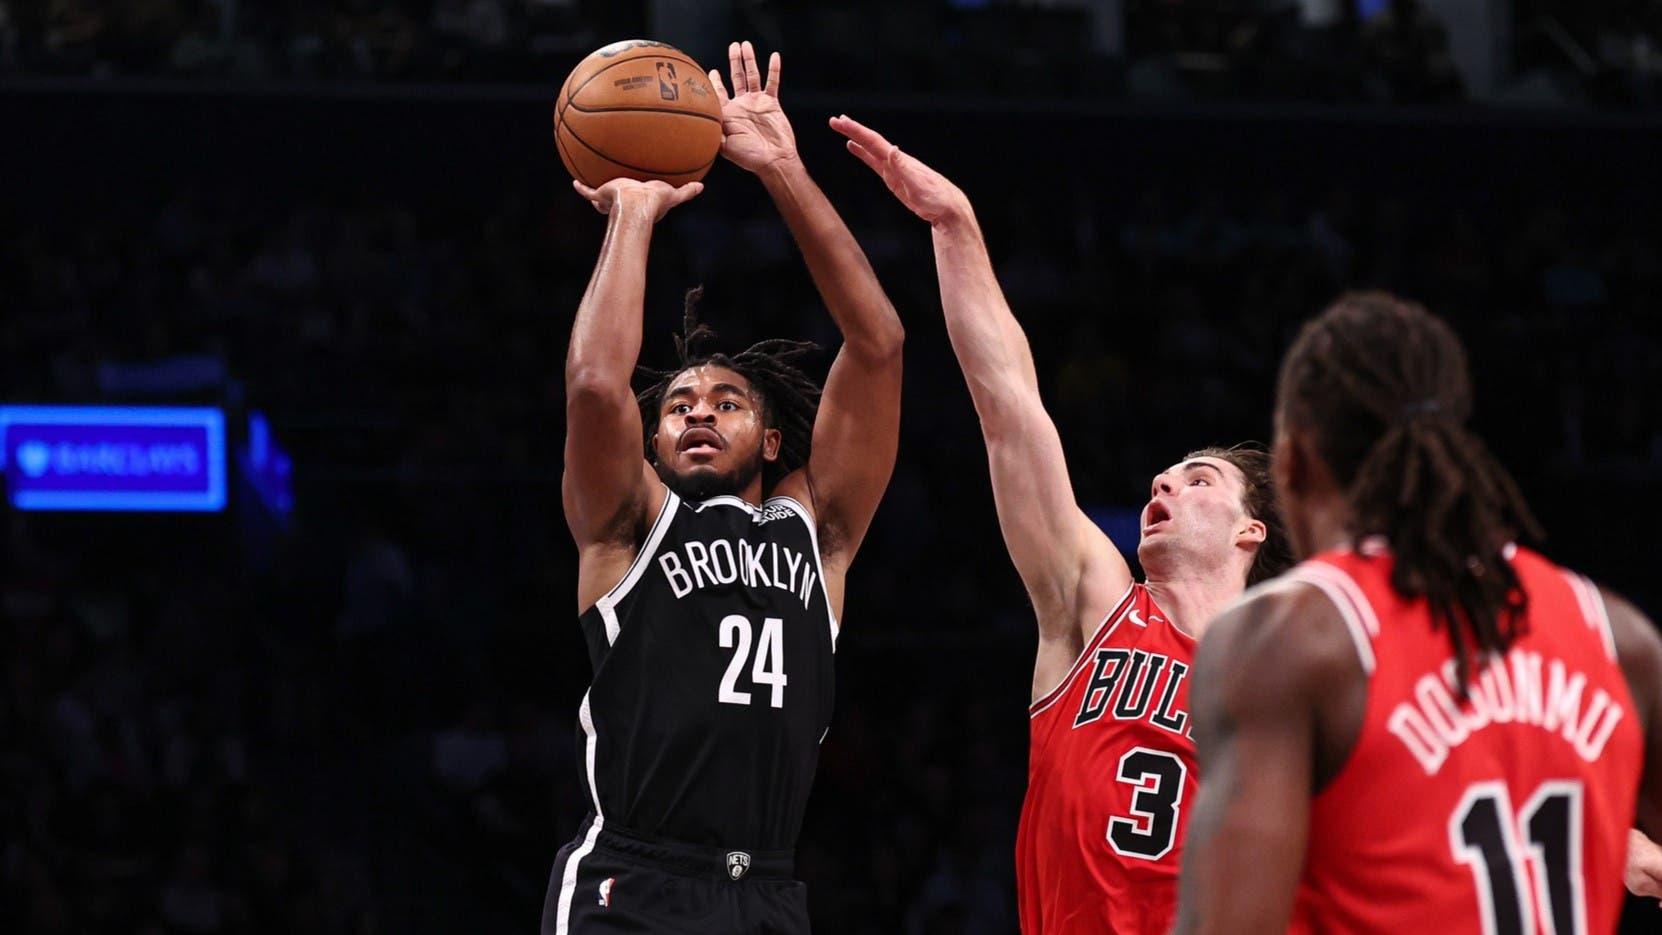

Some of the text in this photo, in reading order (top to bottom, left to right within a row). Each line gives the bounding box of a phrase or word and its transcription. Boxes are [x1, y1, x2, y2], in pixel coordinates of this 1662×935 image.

[658, 538, 817, 610] BROOKLYN
[718, 614, 787, 709] 24
[1072, 648, 1195, 741] BUL
[1106, 746, 1188, 861] 3
[729, 854, 748, 866] NETS
[1447, 780, 1588, 935] 11
